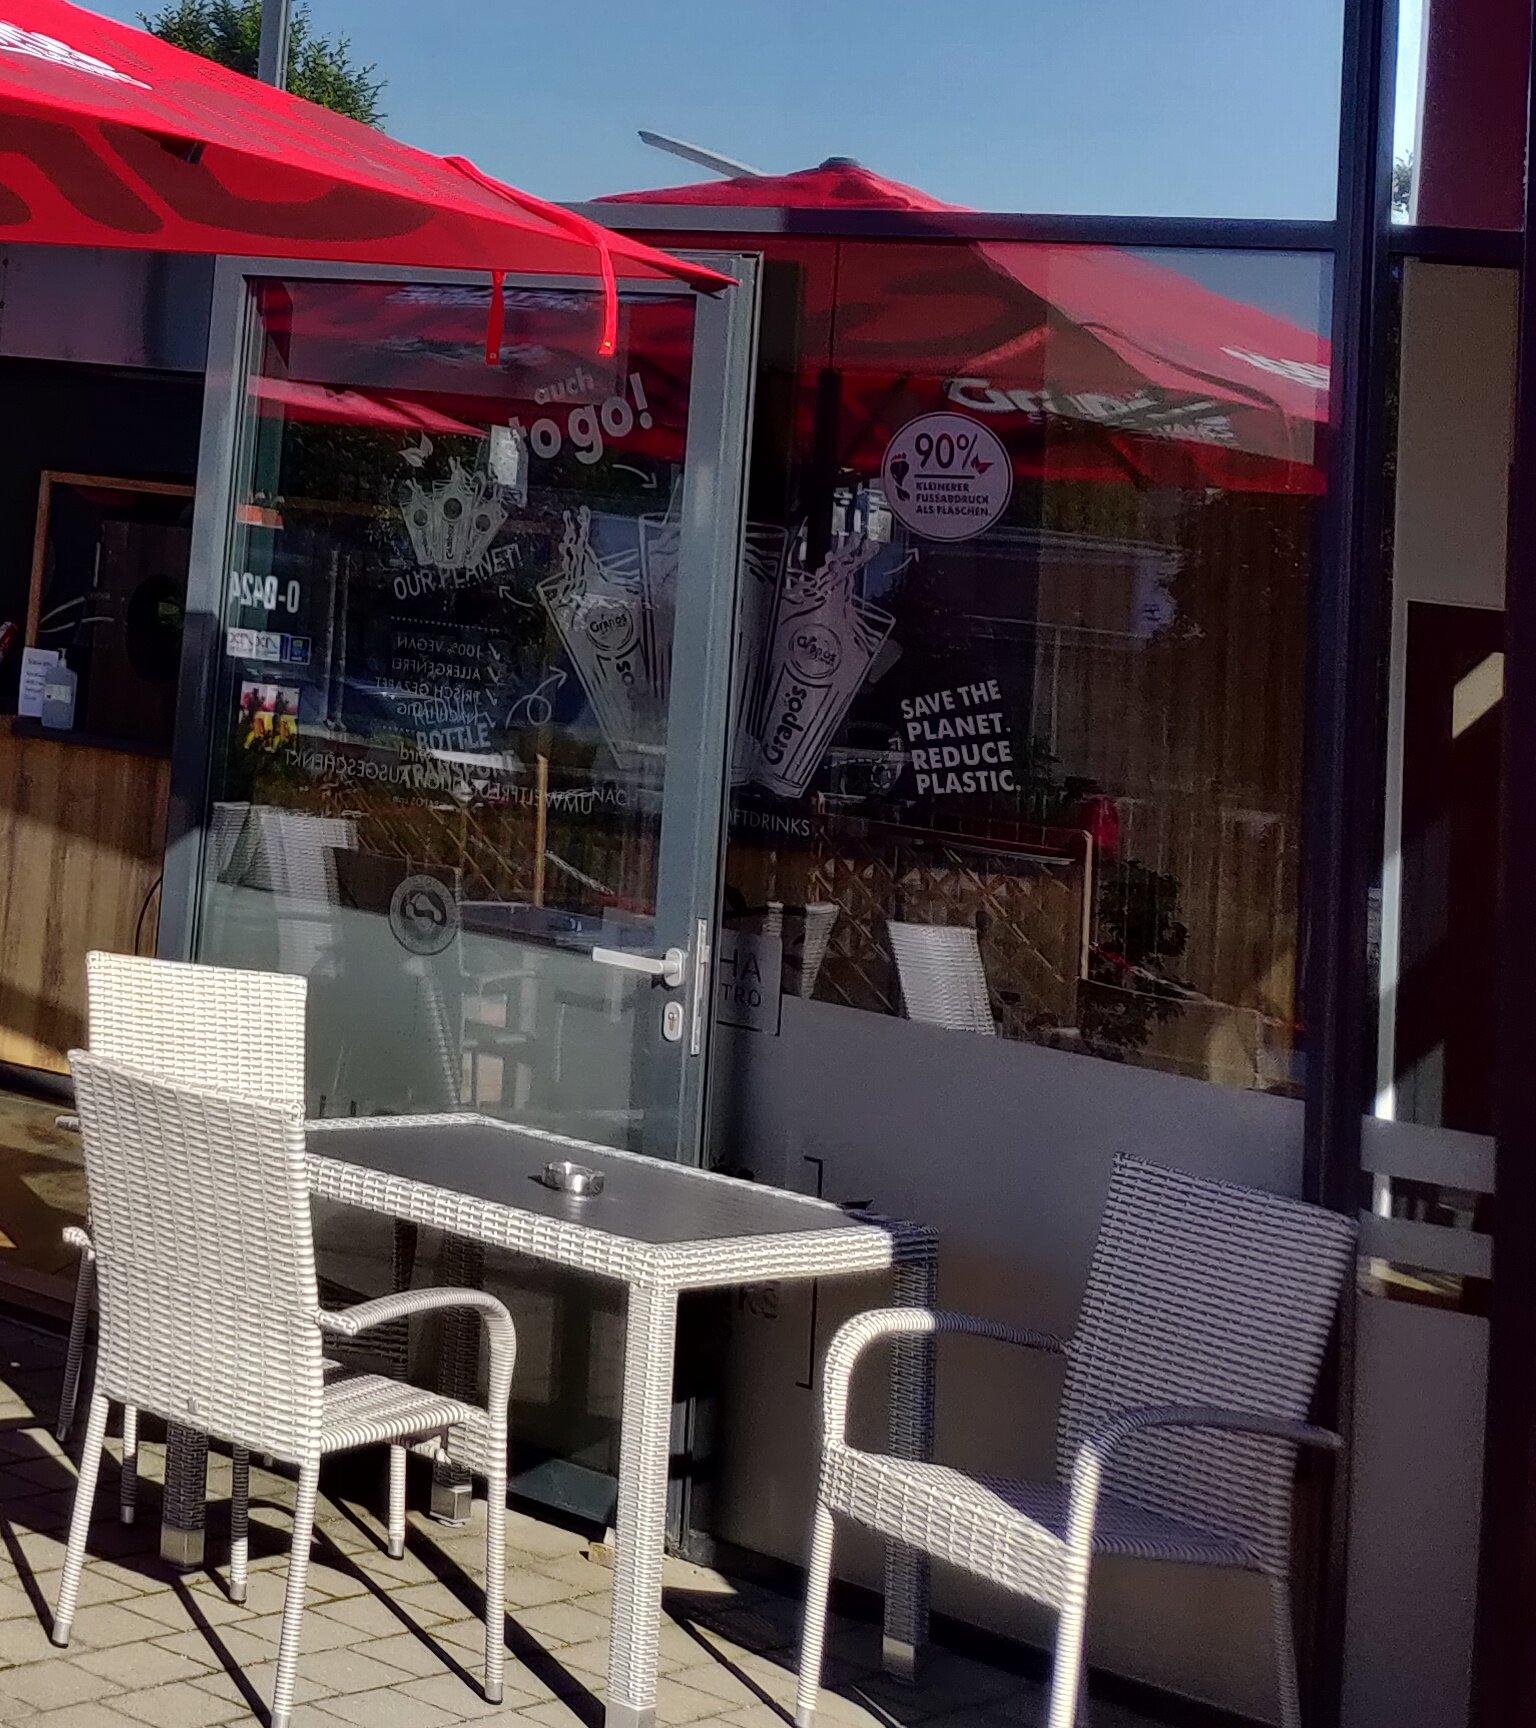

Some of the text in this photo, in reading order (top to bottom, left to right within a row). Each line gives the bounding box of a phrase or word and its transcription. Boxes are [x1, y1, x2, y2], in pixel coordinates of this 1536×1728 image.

[534, 367, 595, 405] auch
[567, 371, 653, 465] go!
[914, 432, 978, 470] 90%
[915, 505, 934, 514] ALS
[900, 678, 1002, 720] SAVE THE
[906, 712, 1011, 742] PLANET.
[911, 740, 1014, 771] REDUCE
[915, 769, 1022, 795] PLASTIC.
